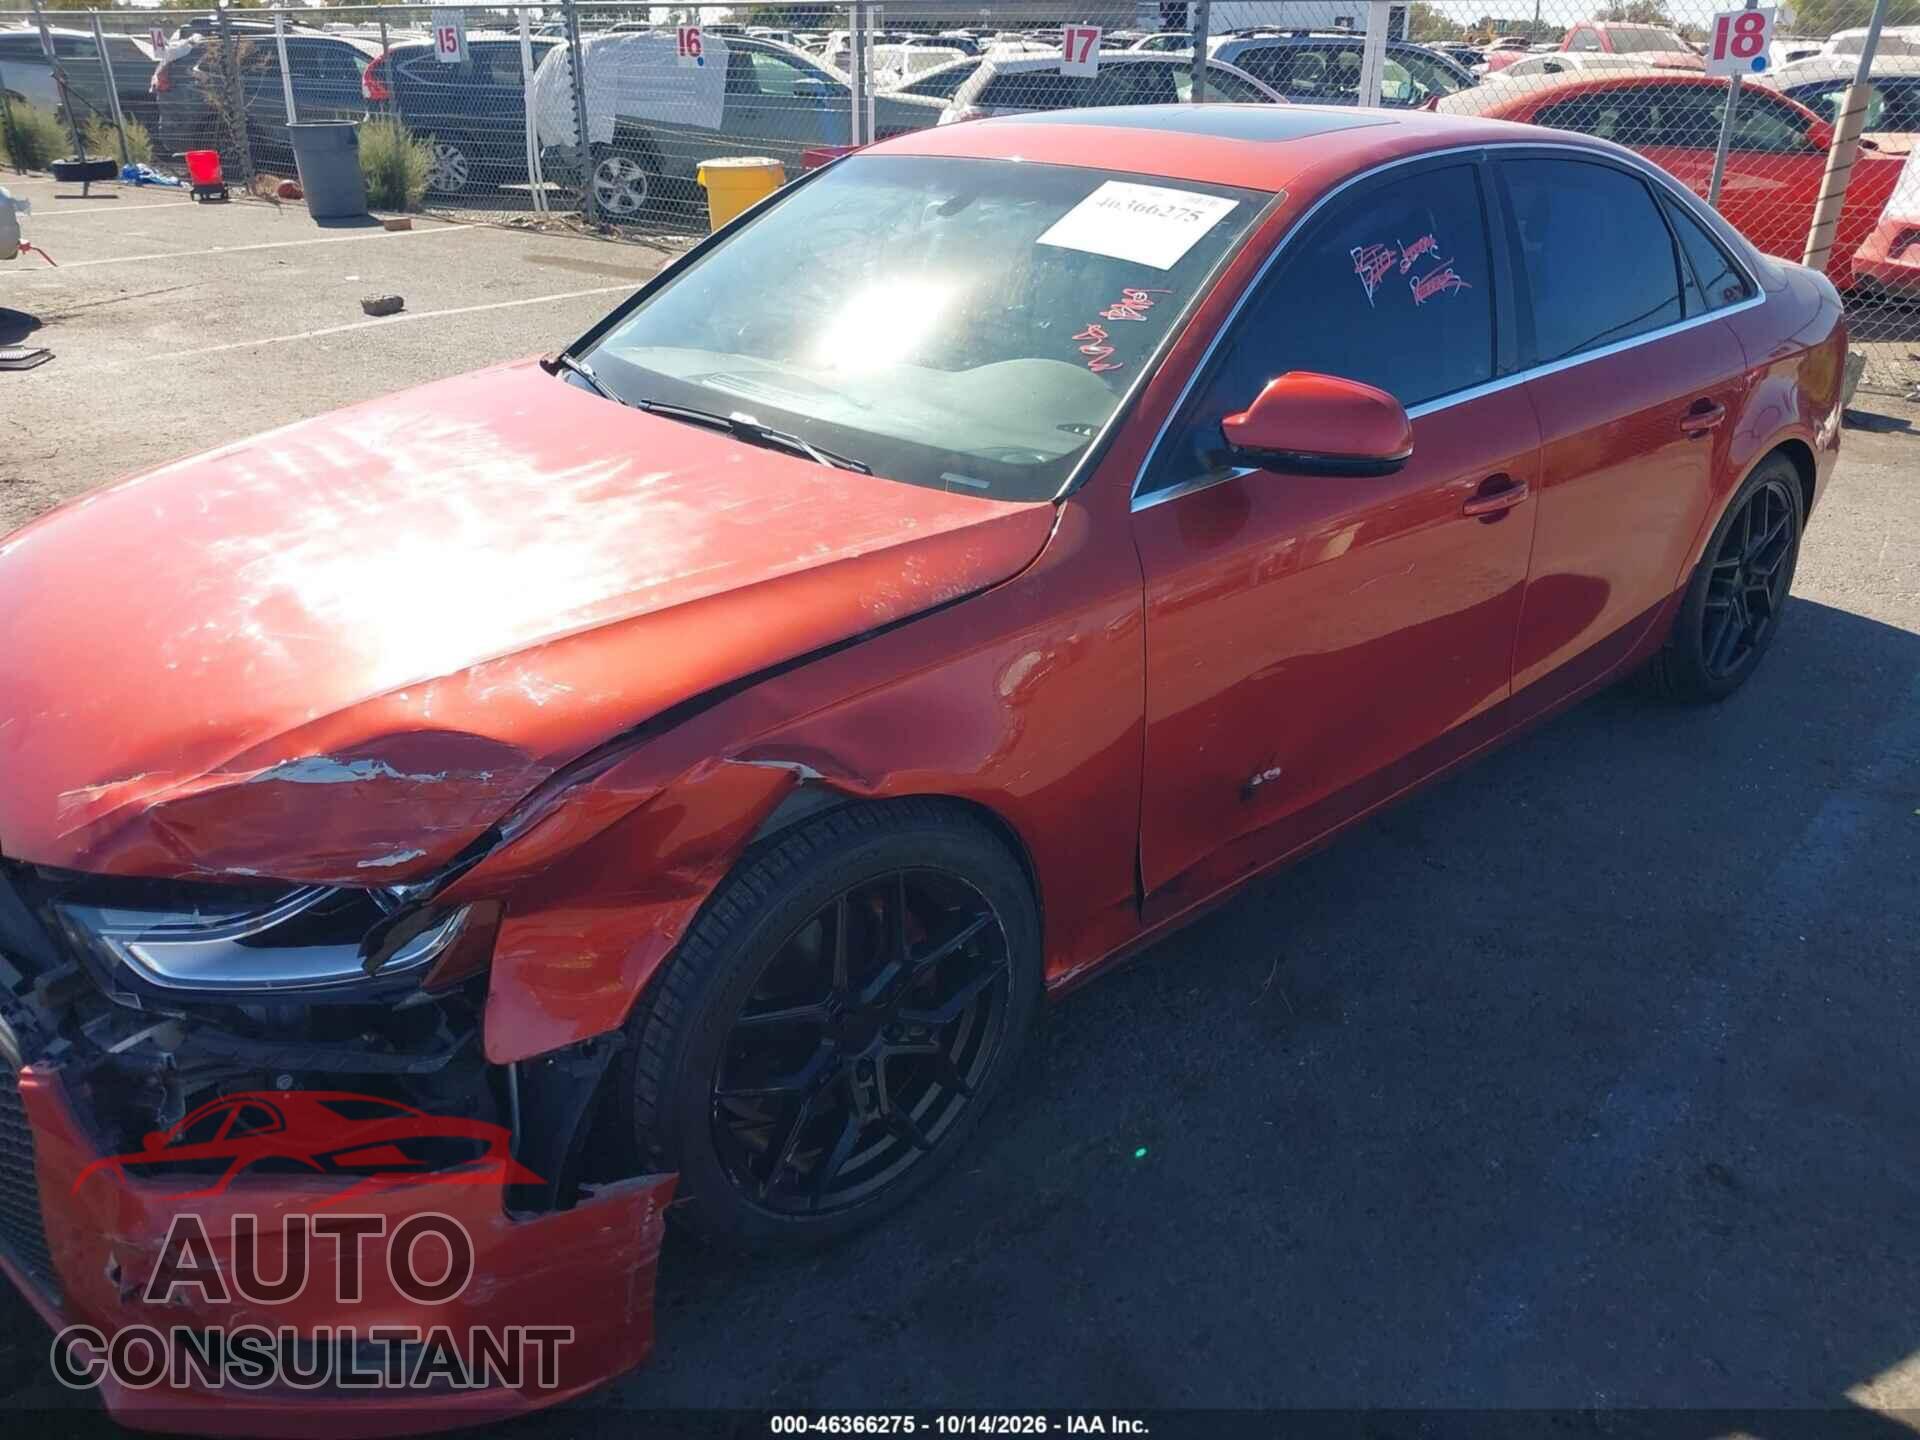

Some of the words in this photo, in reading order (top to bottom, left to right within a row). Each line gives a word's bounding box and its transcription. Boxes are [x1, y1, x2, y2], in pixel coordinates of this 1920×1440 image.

[151, 31, 165, 50] 14
[438, 28, 457, 53] 15
[678, 28, 701, 57] 16
[1064, 29, 1098, 64] 17
[1713, 12, 1765, 60] 18
